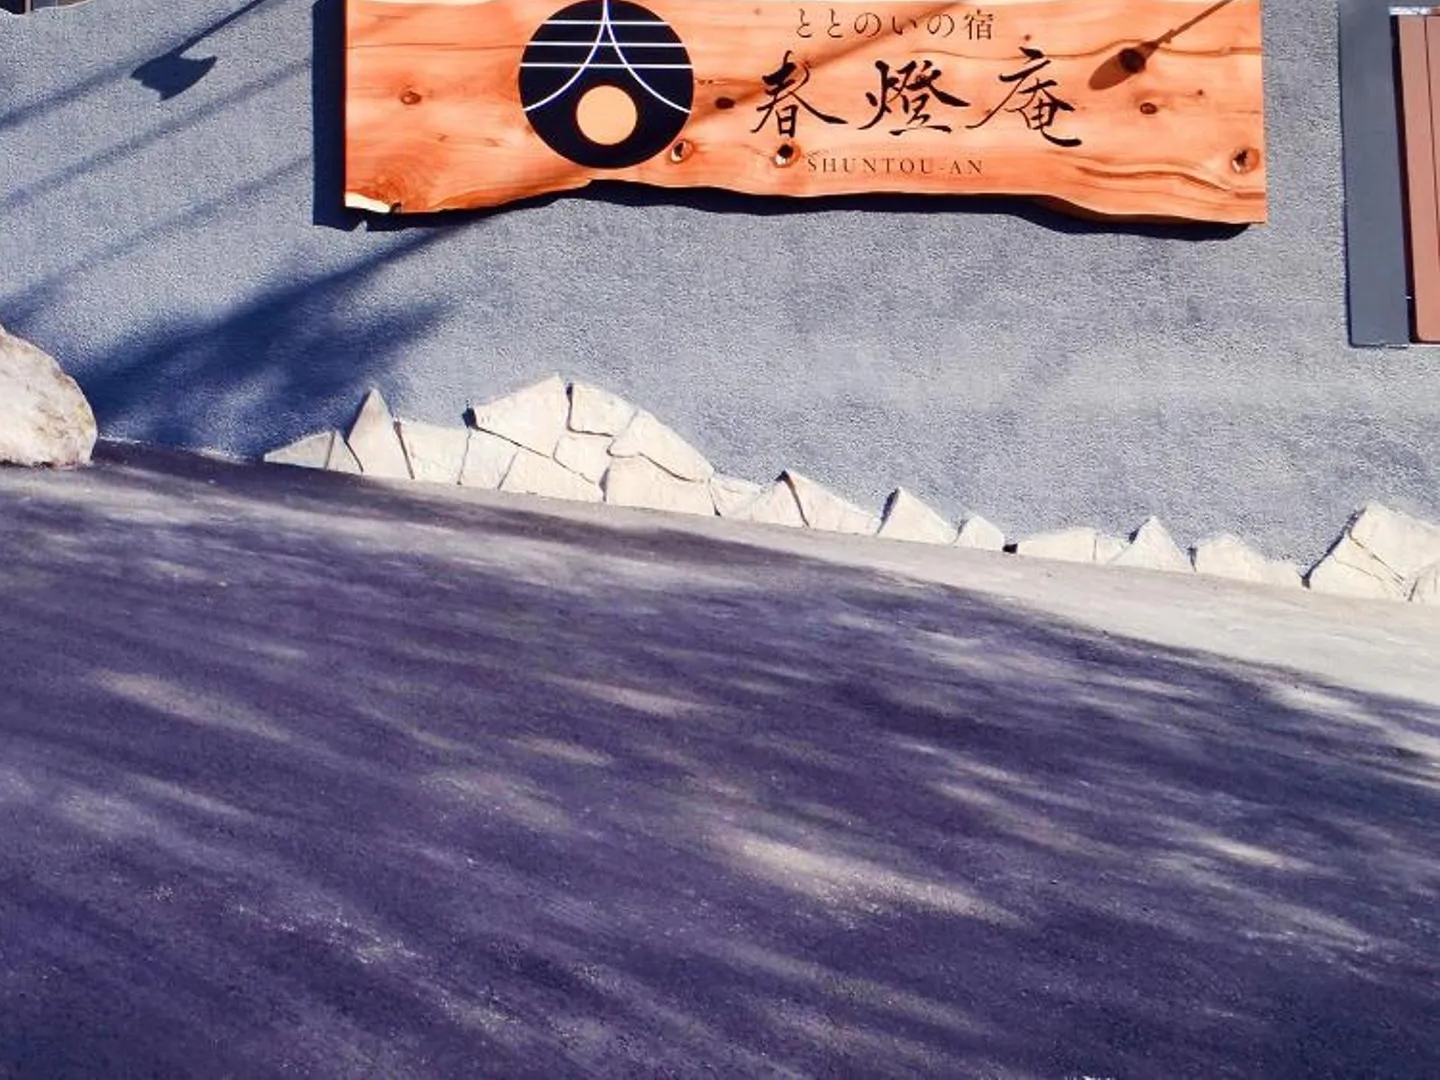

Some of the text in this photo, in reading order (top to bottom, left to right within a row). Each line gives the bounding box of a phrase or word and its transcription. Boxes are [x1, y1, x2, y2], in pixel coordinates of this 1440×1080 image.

[796, 8, 994, 40] ととのいの宿
[750, 46, 1082, 147] 春燈庵
